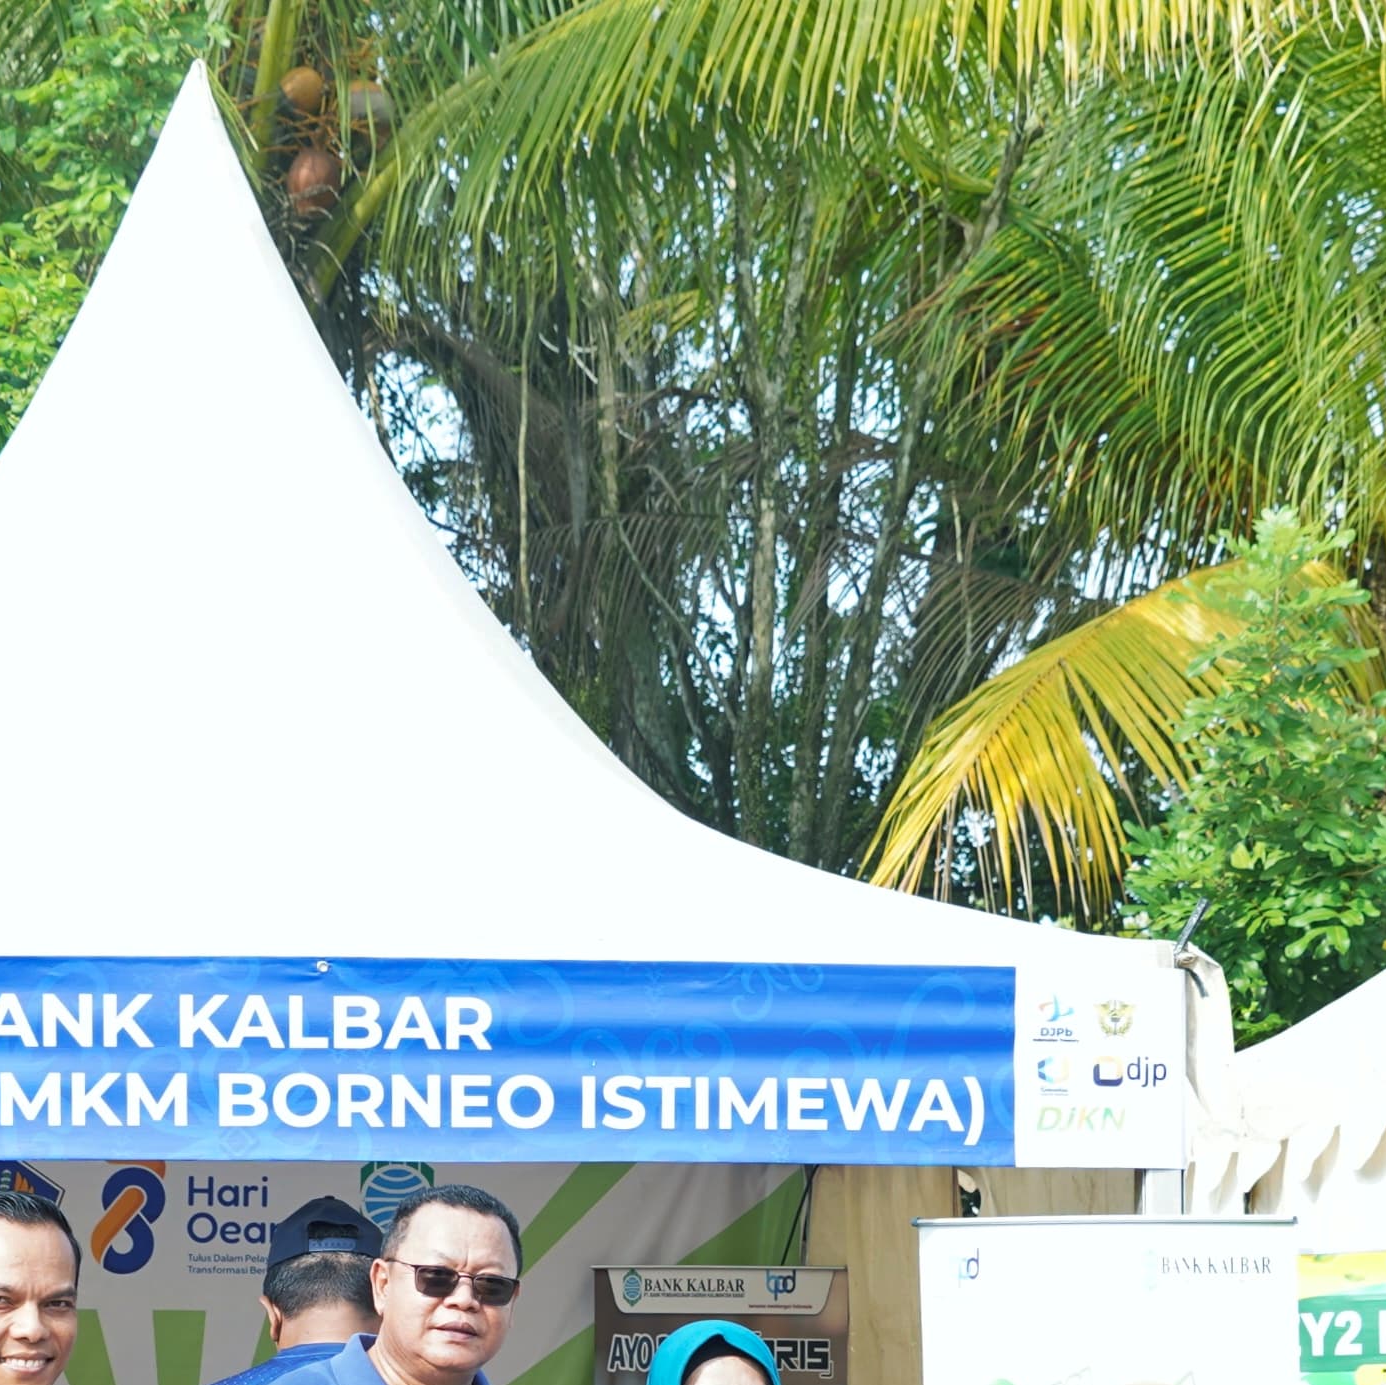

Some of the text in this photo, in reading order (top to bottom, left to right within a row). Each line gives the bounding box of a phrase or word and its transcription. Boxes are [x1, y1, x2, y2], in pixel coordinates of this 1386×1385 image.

[179, 995, 493, 1051] KALBAR
[1127, 1056, 1167, 1087] djp
[218, 1073, 555, 1129] BORNEO
[581, 1075, 986, 1146] ISTIMEWA)
[188, 1176, 268, 1207] Hari
[187, 1212, 277, 1244] Oea
[188, 1254, 268, 1264] Tulus Dalam Pelay
[188, 1265, 267, 1274] Transformasi Ber
[1162, 1257, 1271, 1274] BANK KALBAR
[644, 1278, 745, 1292] BANK KALBAR
[1298, 1311, 1362, 1357] Y2
[608, 1334, 653, 1371] AYO
[769, 1340, 831, 1371] RIS
